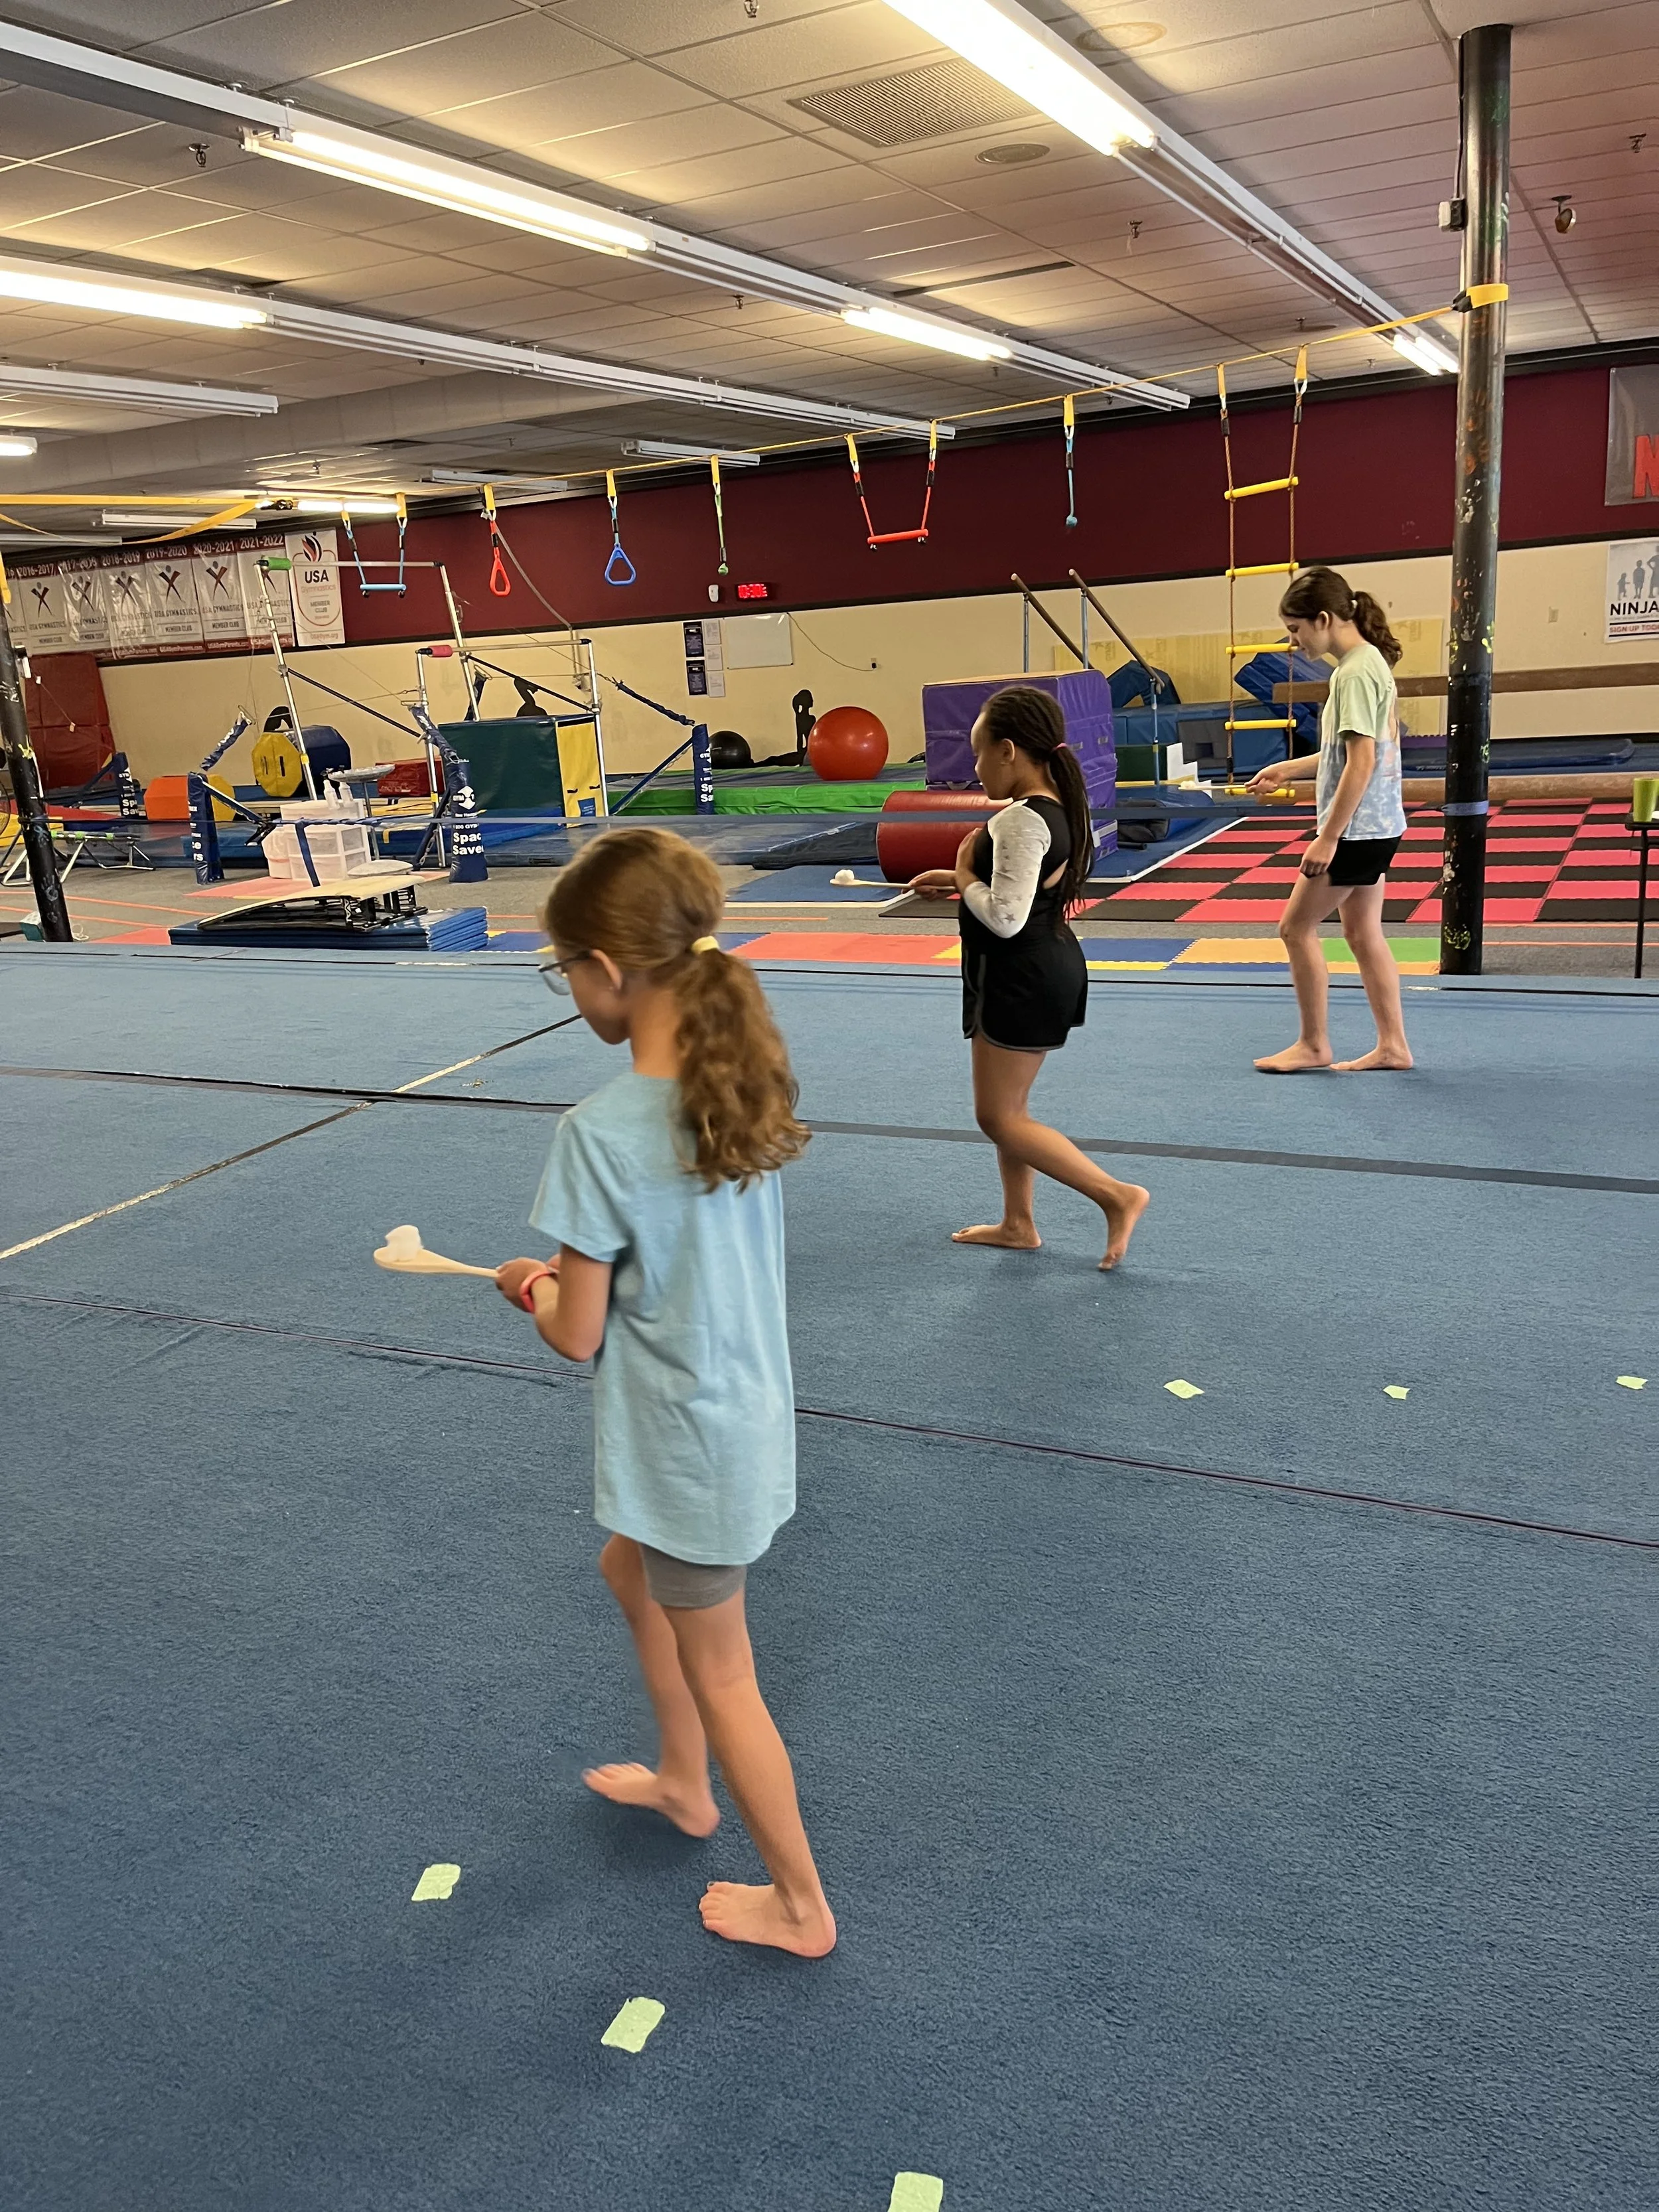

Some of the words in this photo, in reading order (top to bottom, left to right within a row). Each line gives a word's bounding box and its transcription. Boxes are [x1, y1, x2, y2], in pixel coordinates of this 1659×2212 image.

[194, 541, 234, 555] 2020-2021
[240, 535, 284, 549] 2021-2022
[102, 552, 140, 566] 2018-2019
[147, 546, 187, 559] 2019-2020
[18, 563, 54, 577] 2016-2017
[305, 569, 329, 583] USA
[301, 584, 336, 593] Gymnastics
[166, 608, 197, 617] GYMNASTICS
[1610, 601, 1659, 616] NINJA
